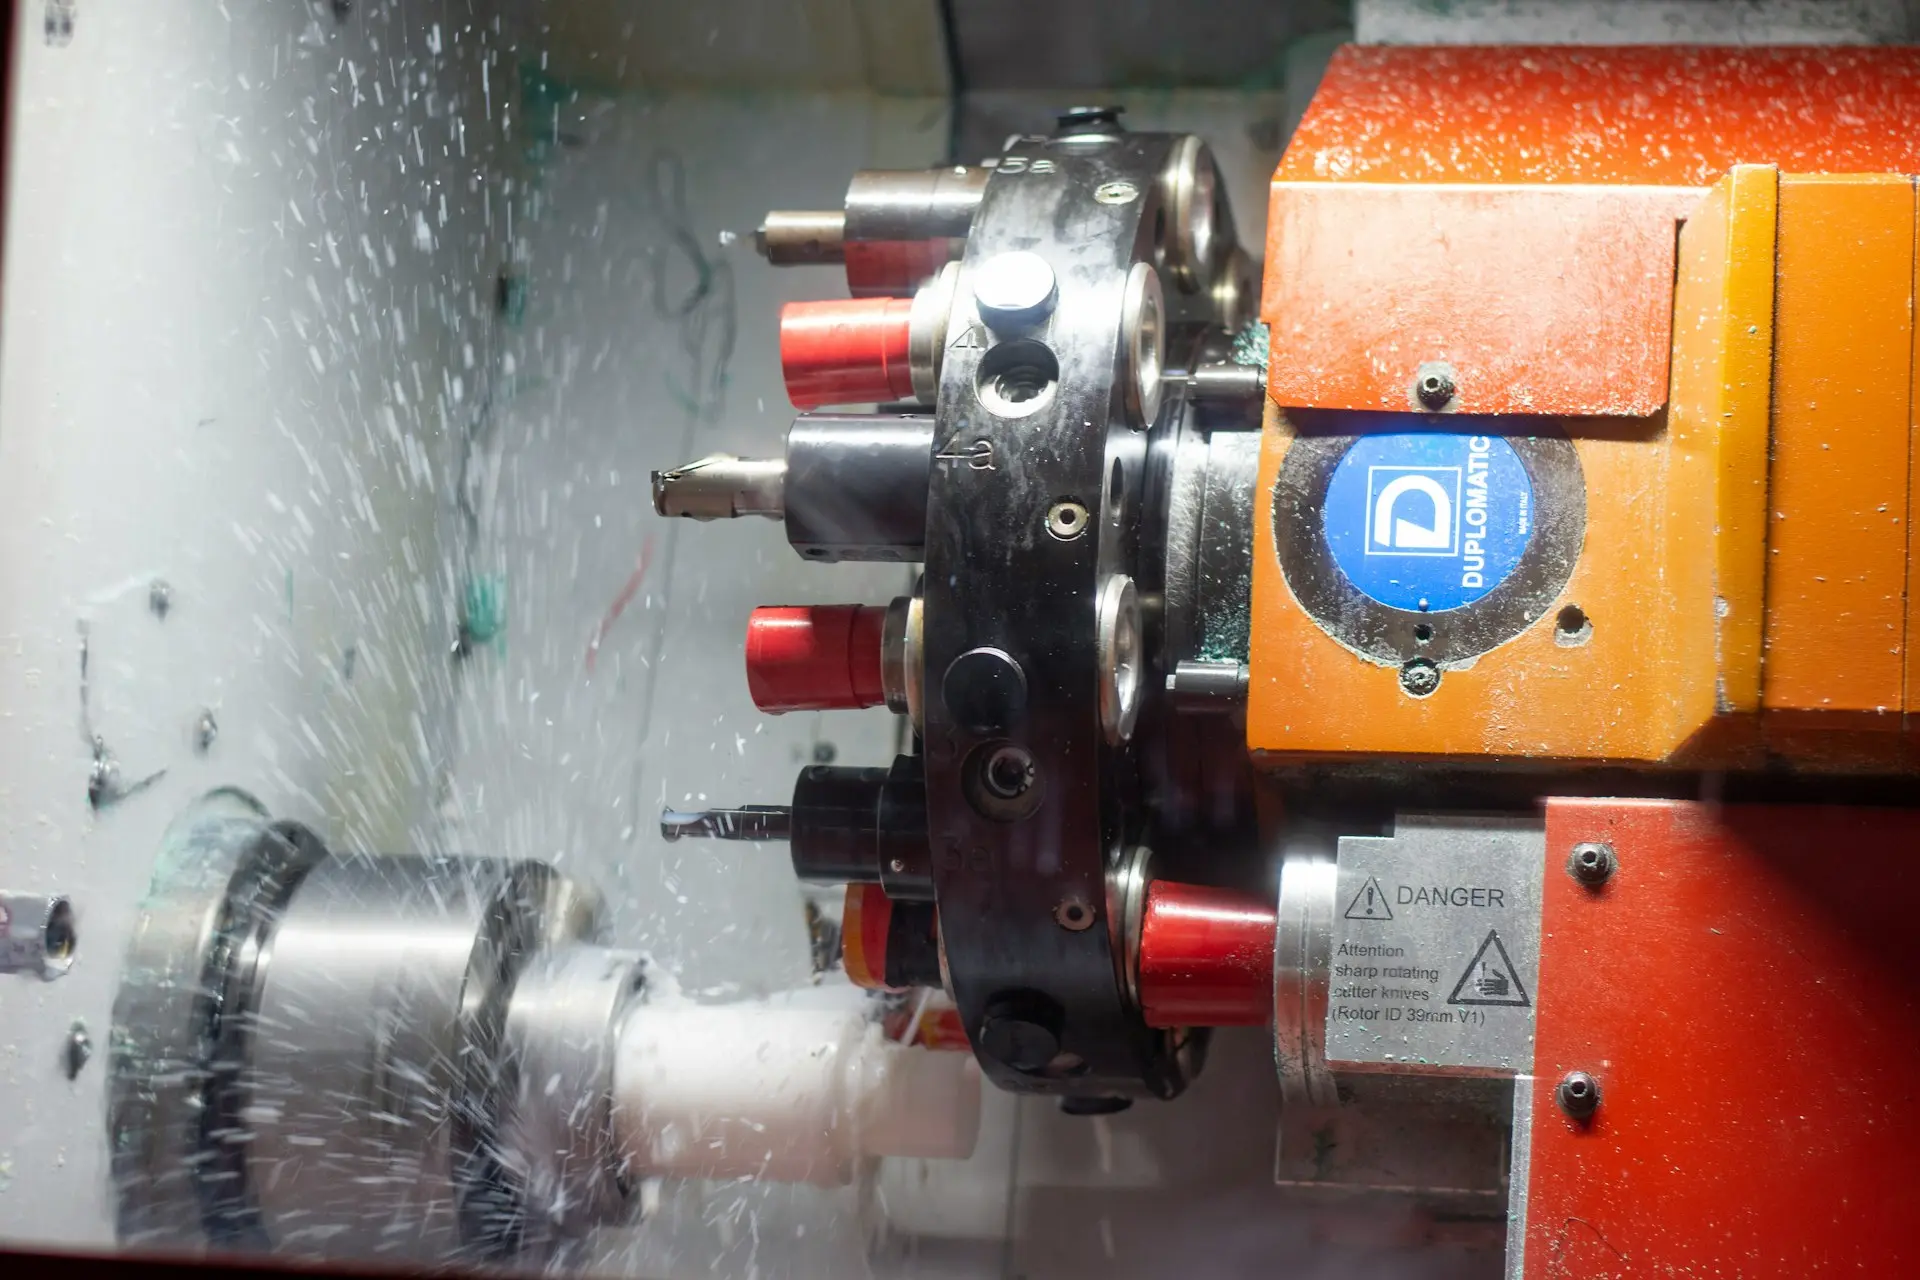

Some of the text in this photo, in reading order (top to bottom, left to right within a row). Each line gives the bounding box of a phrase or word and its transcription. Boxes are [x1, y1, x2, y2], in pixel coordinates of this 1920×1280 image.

[935, 429, 996, 470] 4a
[1462, 436, 1491, 589] DUPLOMATIC
[1397, 885, 1505, 908] DANGER
[1337, 944, 1404, 957] Attention
[1335, 964, 1439, 982] sharp rotating
[1334, 986, 1430, 1000] cutter knives
[1332, 1006, 1485, 1027] (Rotor ID 39mm V1)
